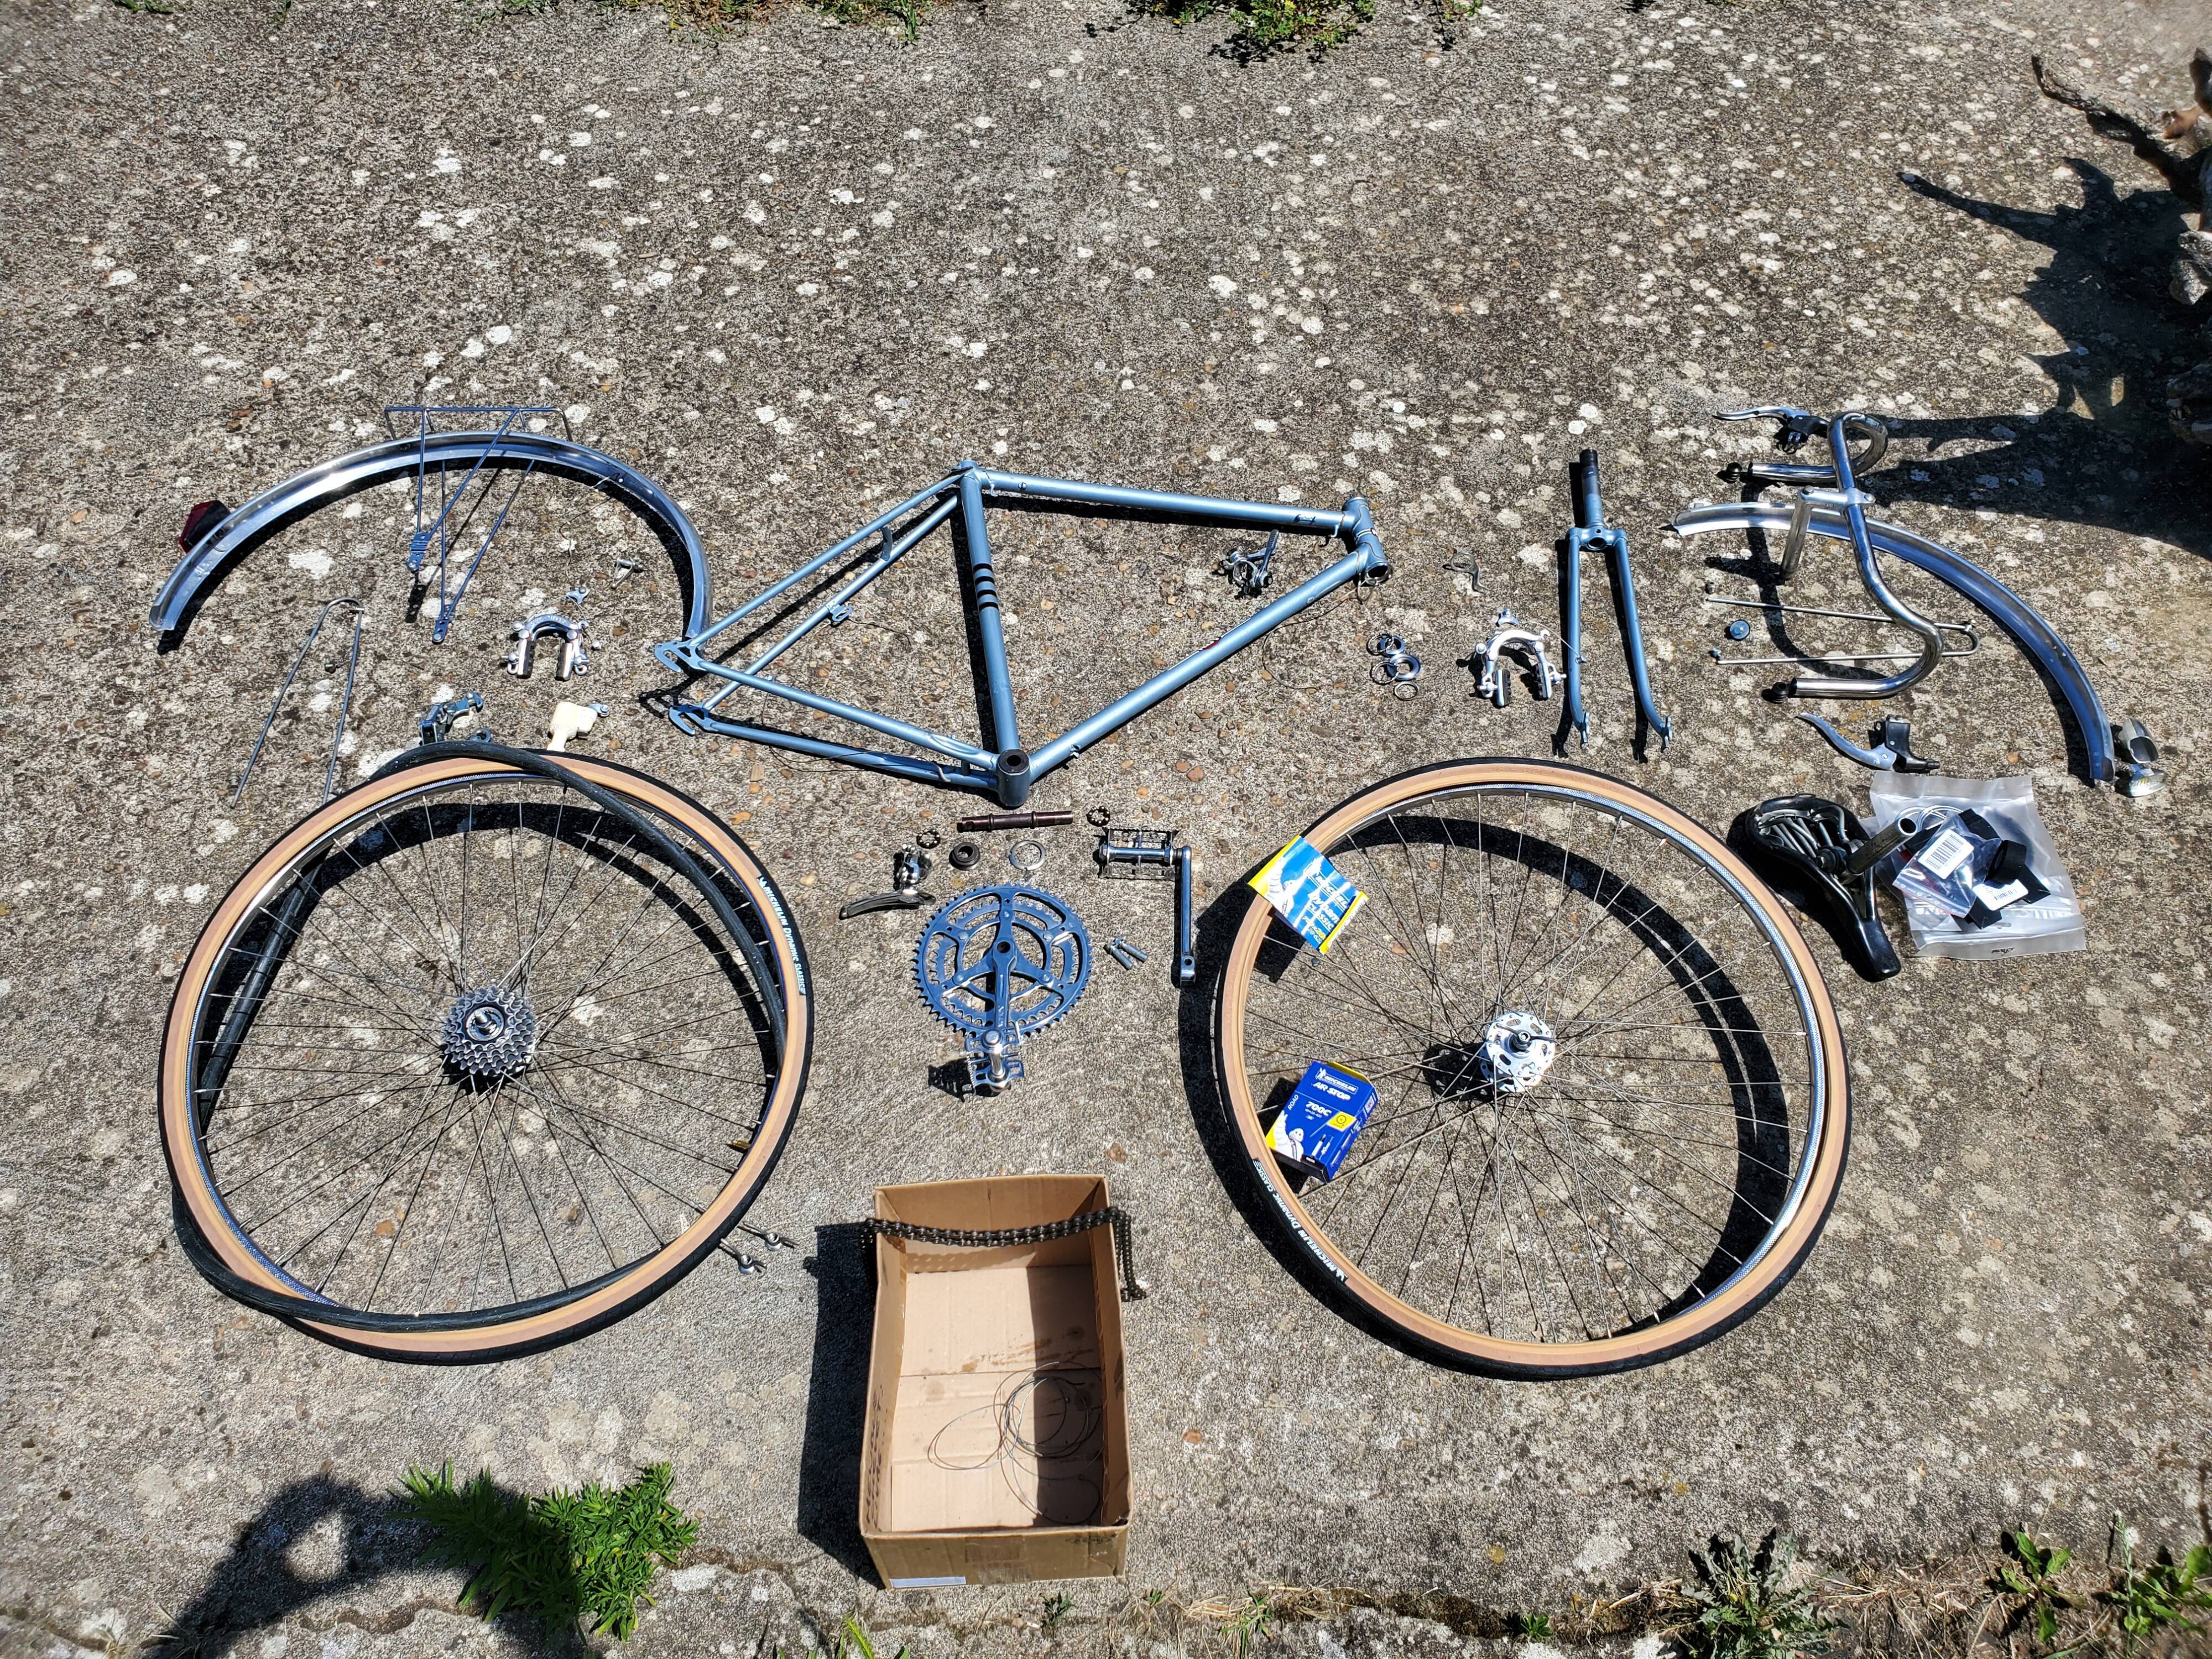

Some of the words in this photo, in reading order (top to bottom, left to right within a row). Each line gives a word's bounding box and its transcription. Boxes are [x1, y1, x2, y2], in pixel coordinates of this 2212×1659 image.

[763, 886, 789, 926] MICHELIN
[783, 927, 799, 962] Dynamic
[795, 963, 805, 989] CLASSIC
[1313, 1082, 1328, 1091] AIR
[1327, 1087, 1351, 1100] STOP
[1324, 1076, 1357, 1092] MICHELIN
[1287, 1094, 1299, 1110] ROAD
[1306, 1101, 1332, 1116] 700C
[1256, 1165, 1274, 1192] CLASSIC
[1272, 1193, 1301, 1229] Dynamic
[1298, 1229, 1337, 1272] MICHELIN
